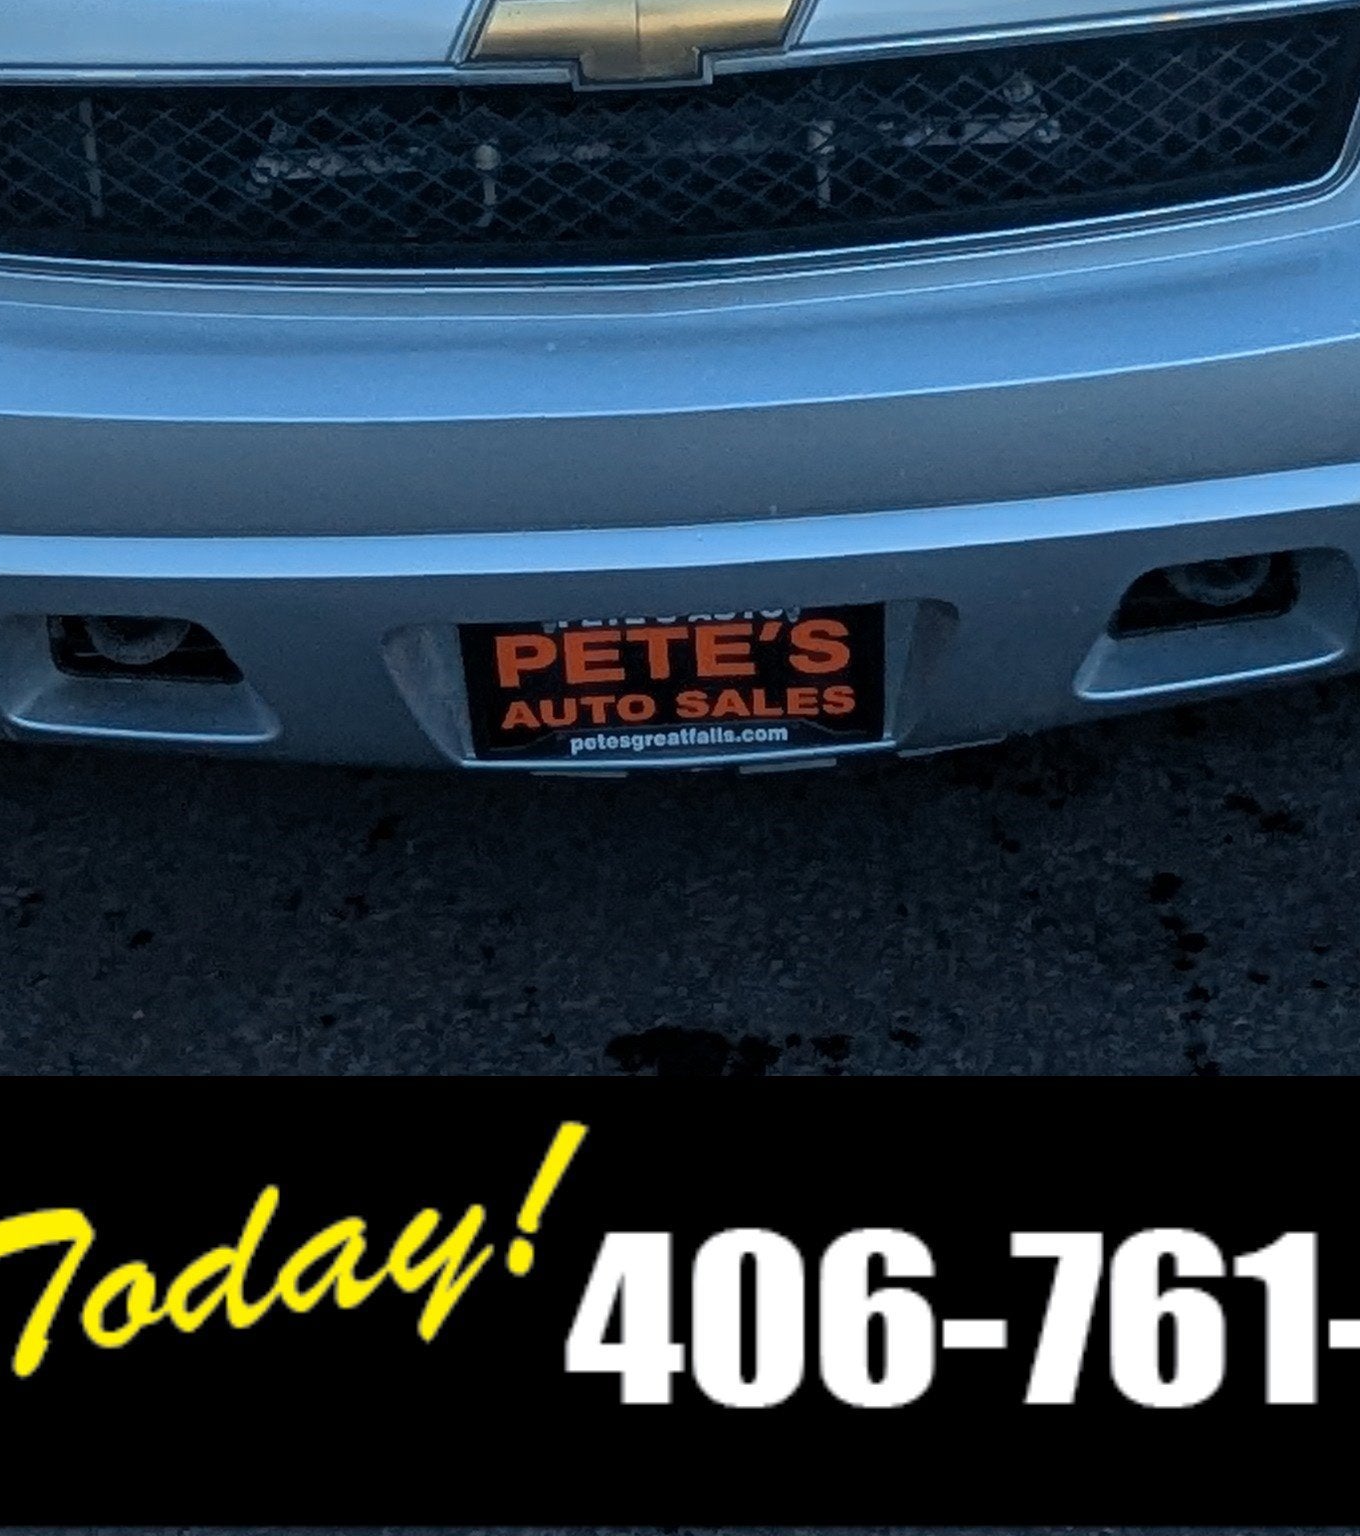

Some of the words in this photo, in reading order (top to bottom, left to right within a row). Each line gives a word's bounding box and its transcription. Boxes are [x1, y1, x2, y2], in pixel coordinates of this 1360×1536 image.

[495, 620, 851, 689] PETE'S
[501, 694, 657, 730] AUTO
[676, 685, 857, 719] SALES
[569, 725, 789, 755] petesgreatfalls.com
